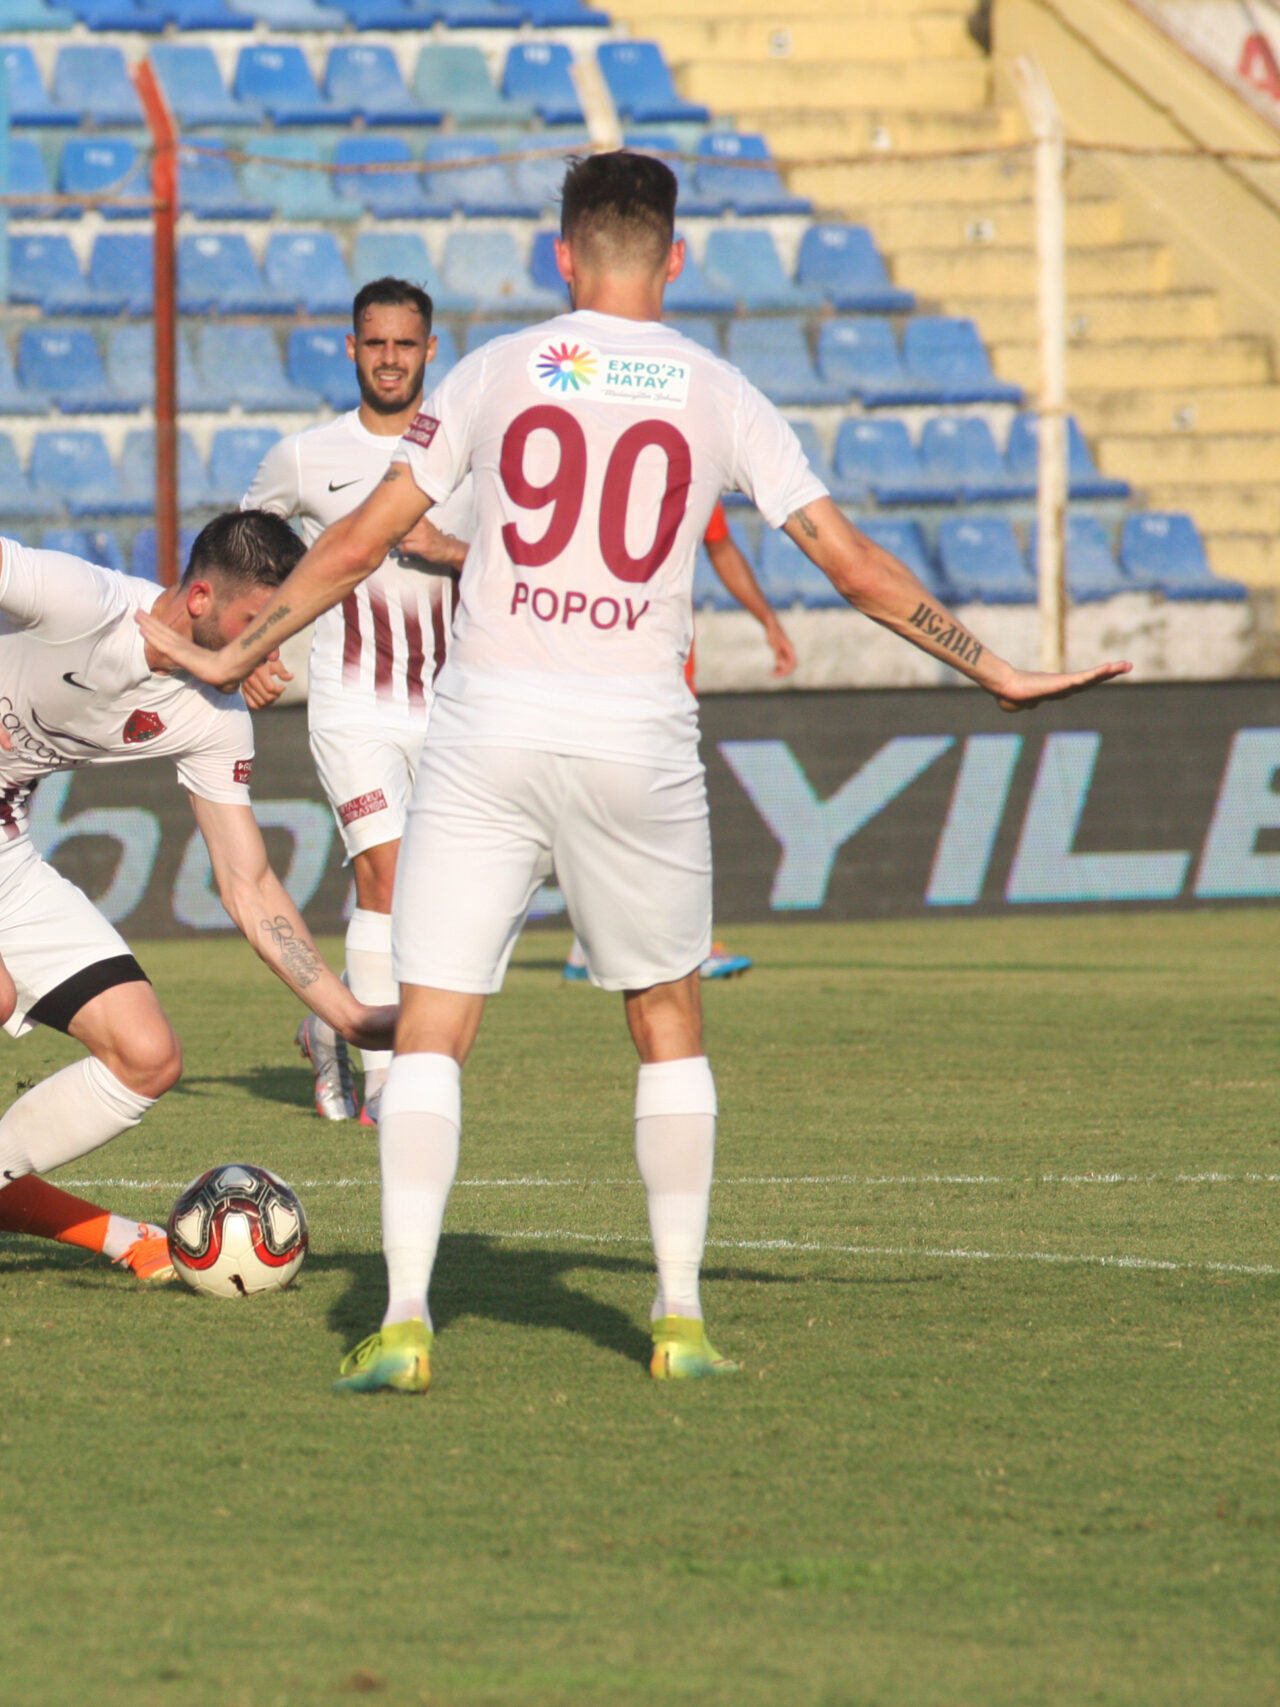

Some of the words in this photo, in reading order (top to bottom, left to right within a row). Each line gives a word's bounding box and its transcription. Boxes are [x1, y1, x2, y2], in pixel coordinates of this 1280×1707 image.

[606, 373, 669, 390] HATAY
[608, 359, 685, 379] EXPO'21
[500, 404, 692, 583] 90
[510, 582, 650, 630] POPOV
